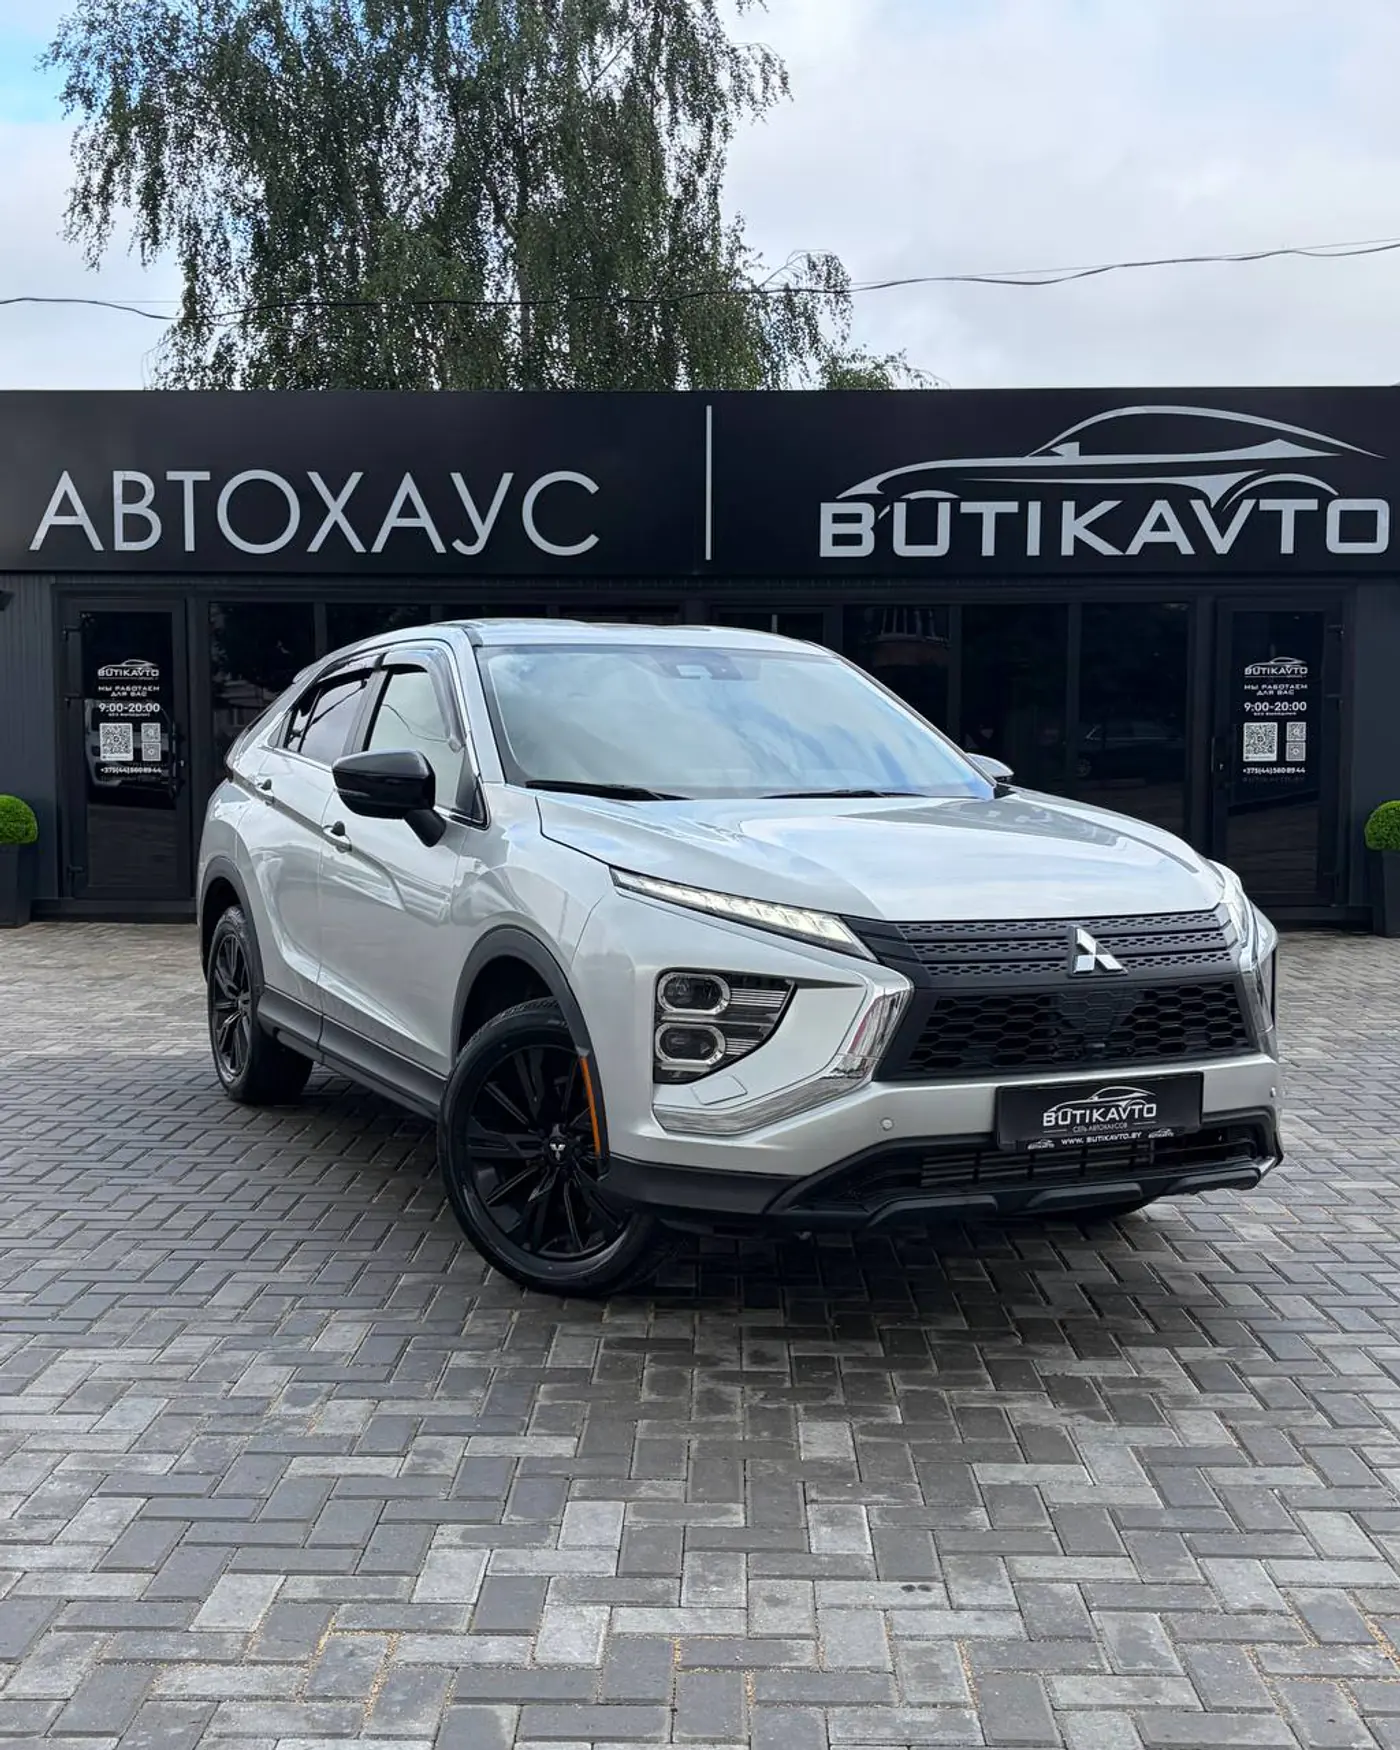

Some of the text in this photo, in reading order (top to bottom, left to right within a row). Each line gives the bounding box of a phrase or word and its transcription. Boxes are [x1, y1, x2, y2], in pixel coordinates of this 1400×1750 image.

[29, 469, 600, 556] АВТОХАУС
[819, 498, 1389, 558] BUTIKAVTO
[98, 668, 160, 677] BUTIKAVTO
[1244, 666, 1308, 675] BUTIKAVTO
[99, 703, 160, 712] 9:00-20:00
[1244, 701, 1307, 712] 9:00-20:00
[1042, 1103, 1157, 1127] BUTIKAVTO
